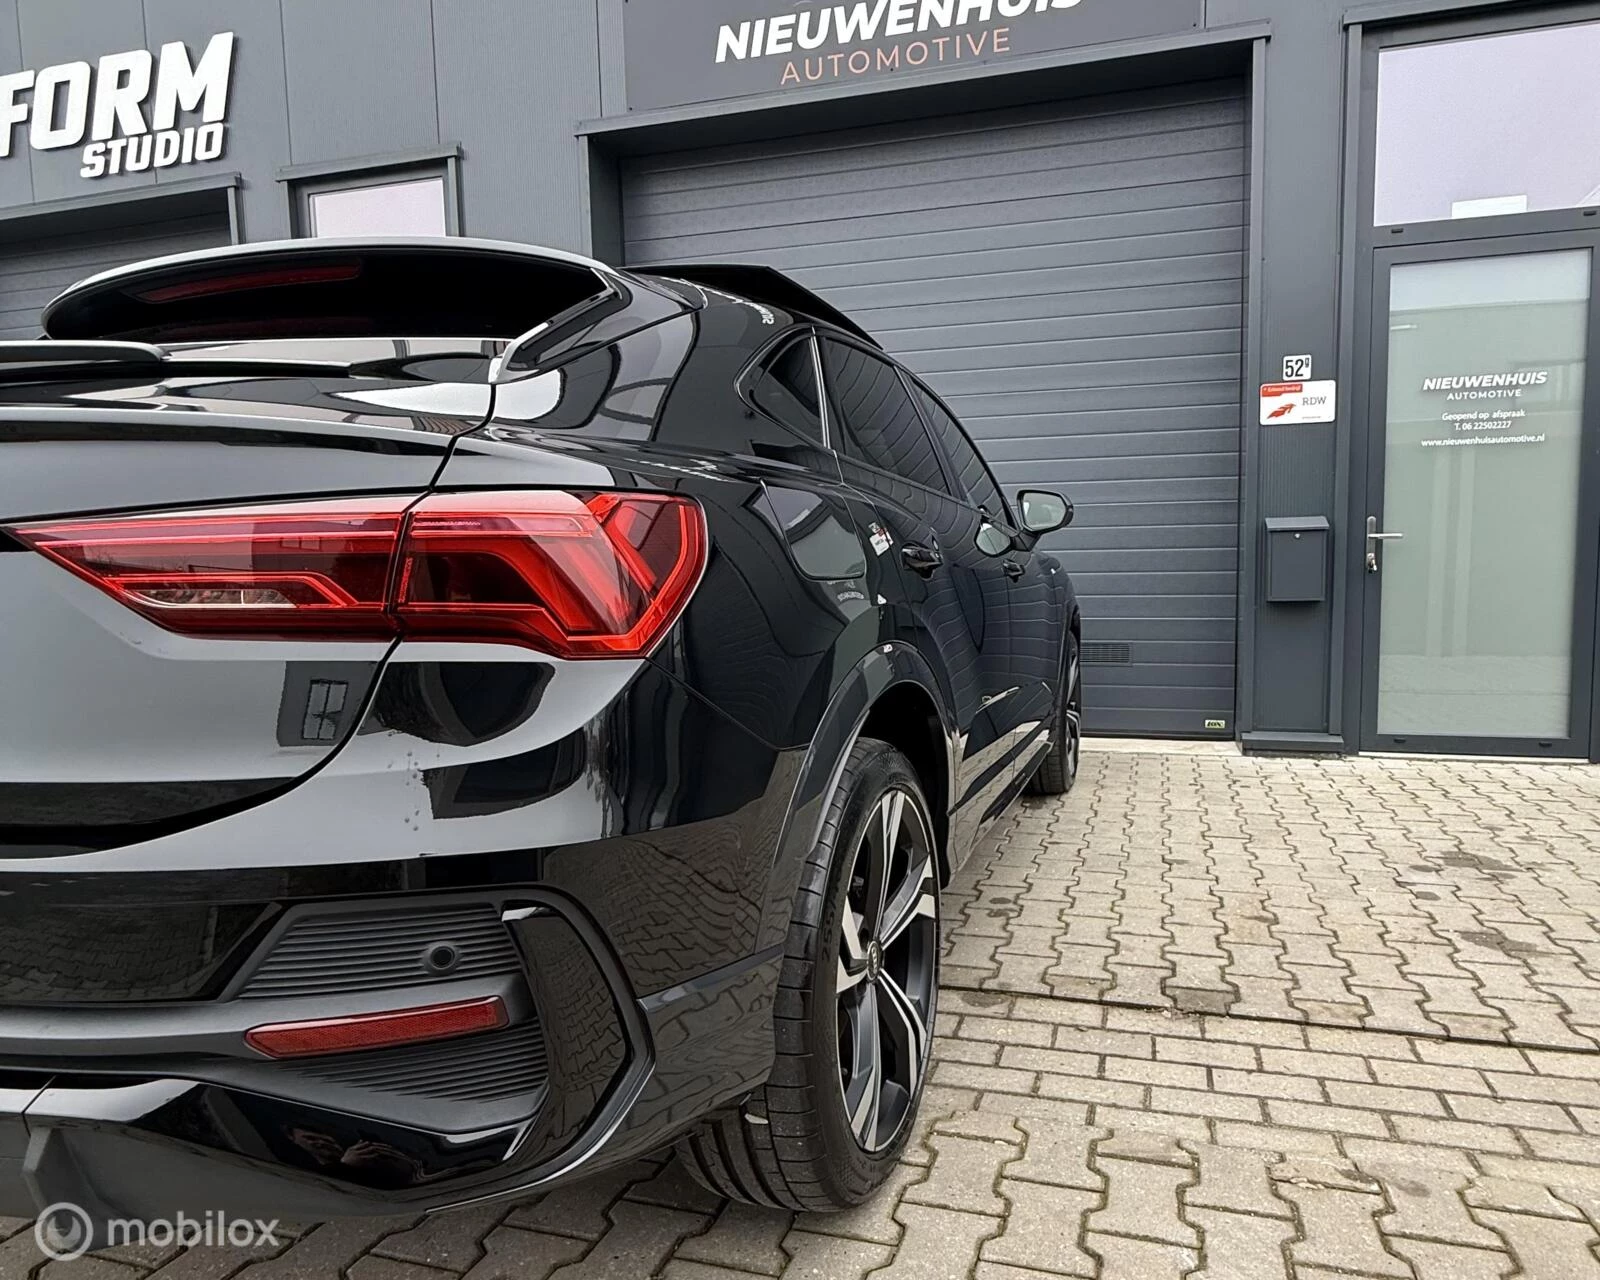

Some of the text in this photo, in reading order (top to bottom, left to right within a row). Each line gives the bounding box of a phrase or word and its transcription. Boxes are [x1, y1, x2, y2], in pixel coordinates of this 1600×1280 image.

[715, 0, 1082, 63] NIEUWENH
[780, 27, 1010, 85] AUTOMOTIVE
[0, 31, 234, 157] FORM
[80, 122, 224, 178] STUDIO
[1422, 371, 1548, 390] NIEUWENHUIS
[1302, 396, 1327, 406] RDW
[1447, 389, 1522, 401] AUTOMOTIVE
[1442, 409, 1526, 422] Geopend op afspraak
[1454, 420, 1512, 431] T. 06 22502227
[1421, 433, 1545, 447] www.nieuwenhuisautomotive.nl
